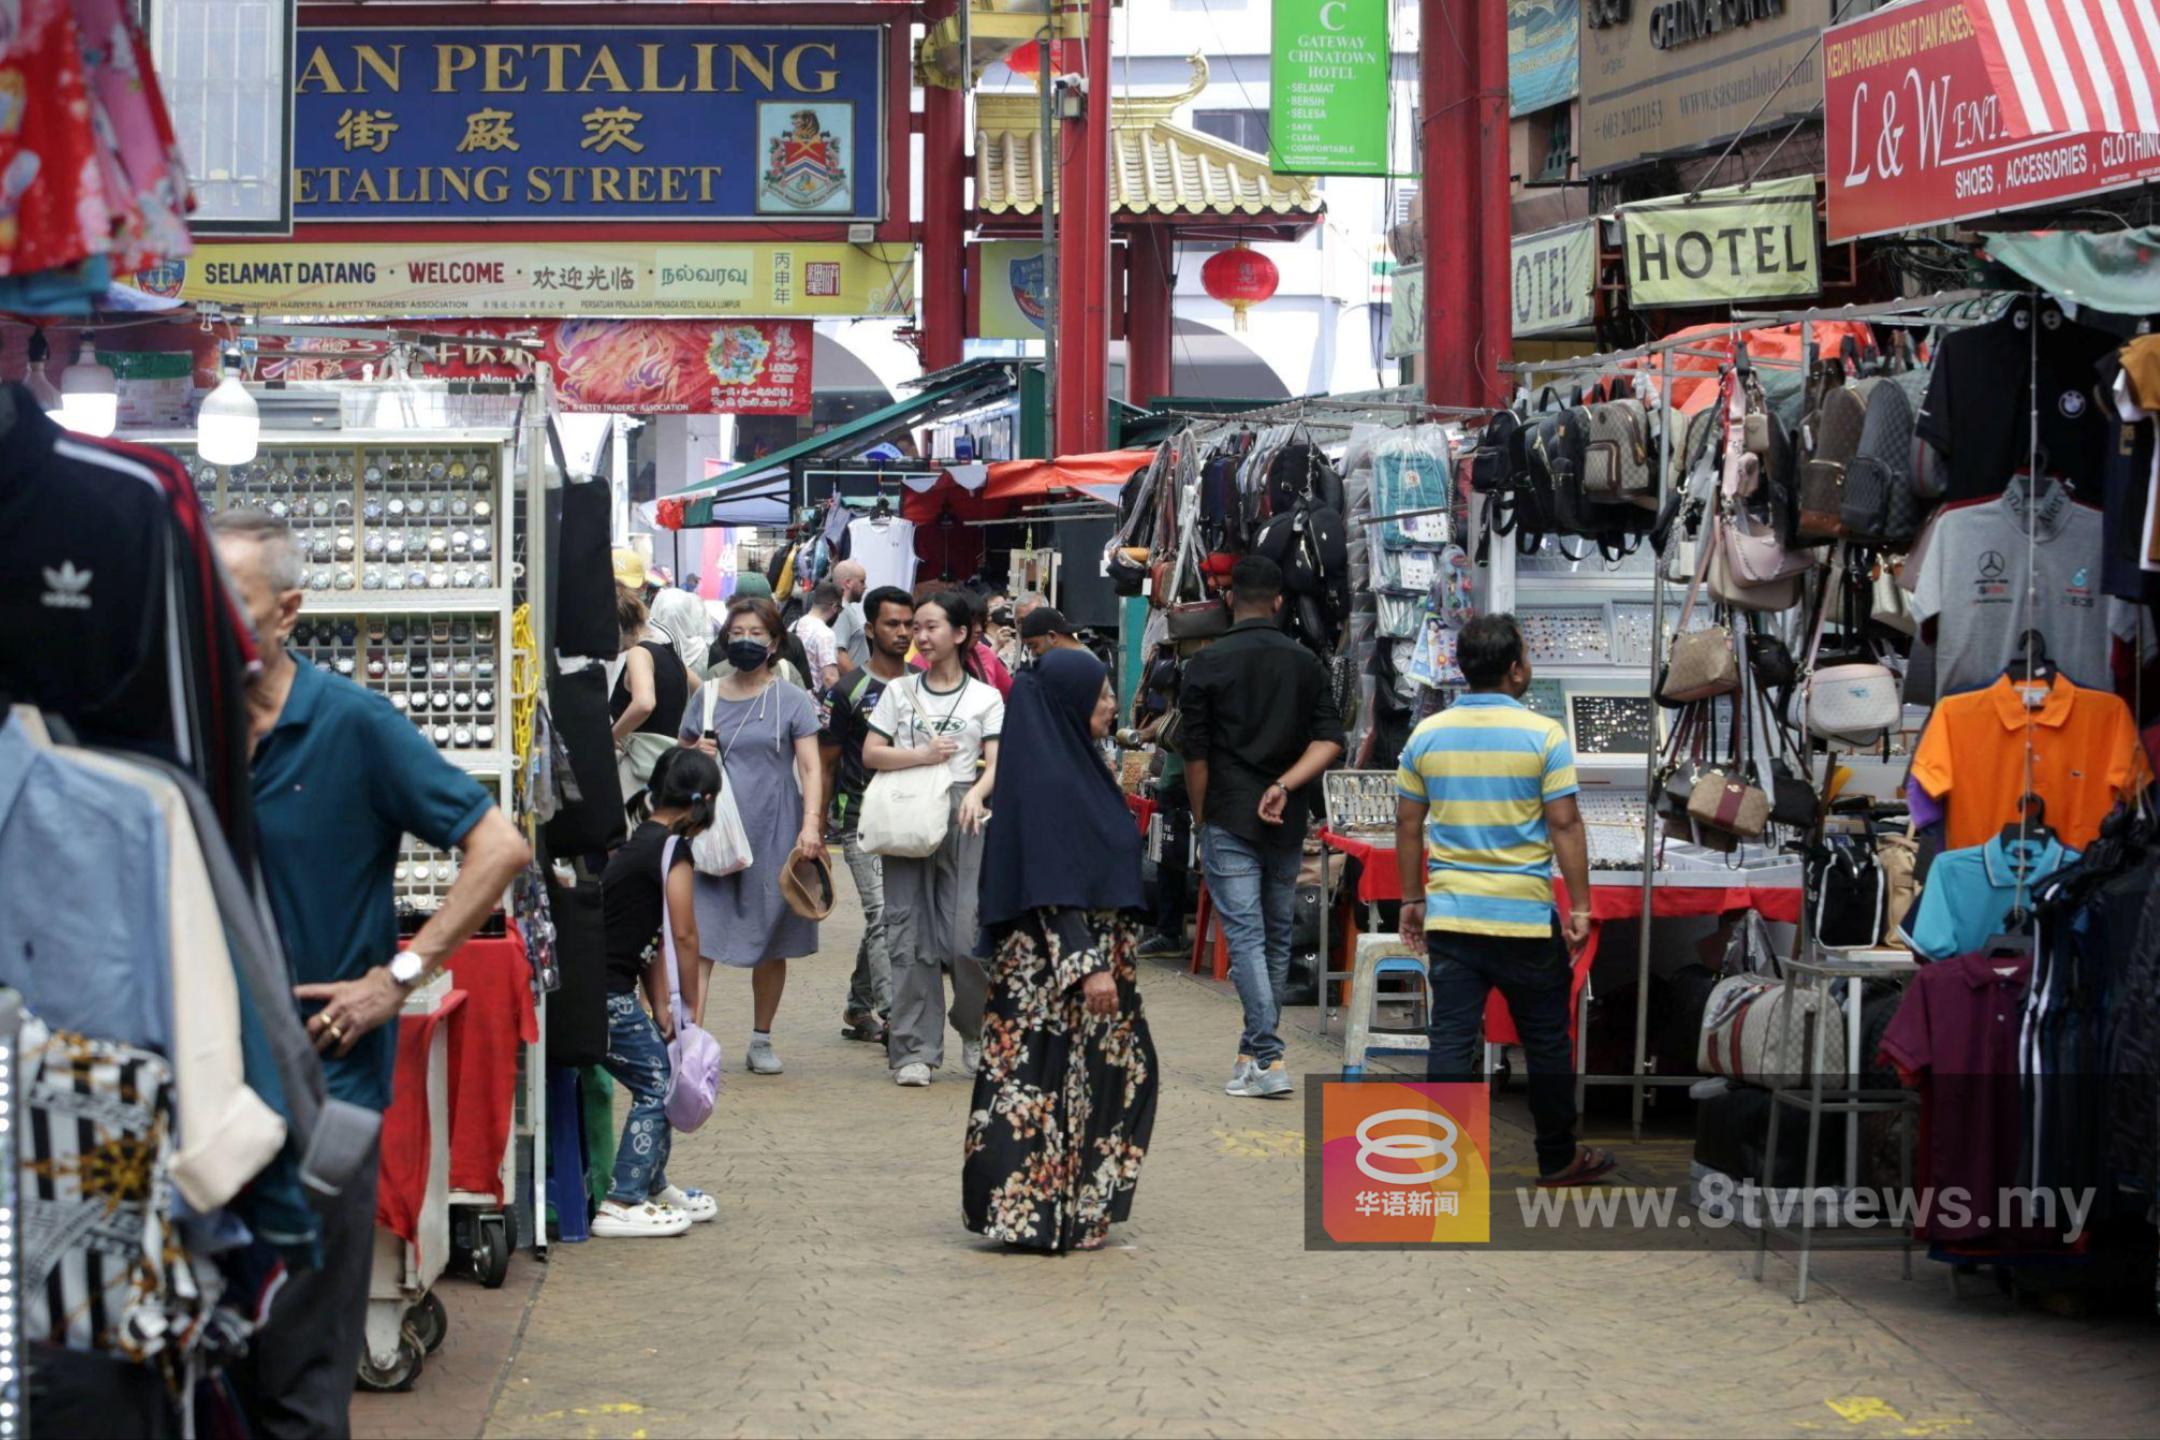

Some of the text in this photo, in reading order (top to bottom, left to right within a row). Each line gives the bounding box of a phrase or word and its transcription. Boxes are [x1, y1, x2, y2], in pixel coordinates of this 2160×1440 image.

[1297, 35, 1366, 49] GATEWAY
[1288, 50, 1377, 64] CHINATOWN
[431, 43, 840, 94] PETALING
[1308, 66, 1356, 79] HOTEL
[1291, 83, 1334, 94] SELAMAT
[527, 166, 722, 203] STREET
[1636, 224, 1807, 282] HOTEL
[205, 263, 293, 284] SELAMAT
[298, 263, 376, 284] DATANG
[408, 262, 504, 284] WELCOME
[533, 265, 635, 291] 欢迎光临
[410, 301, 469, 309] ASSOCIATION
